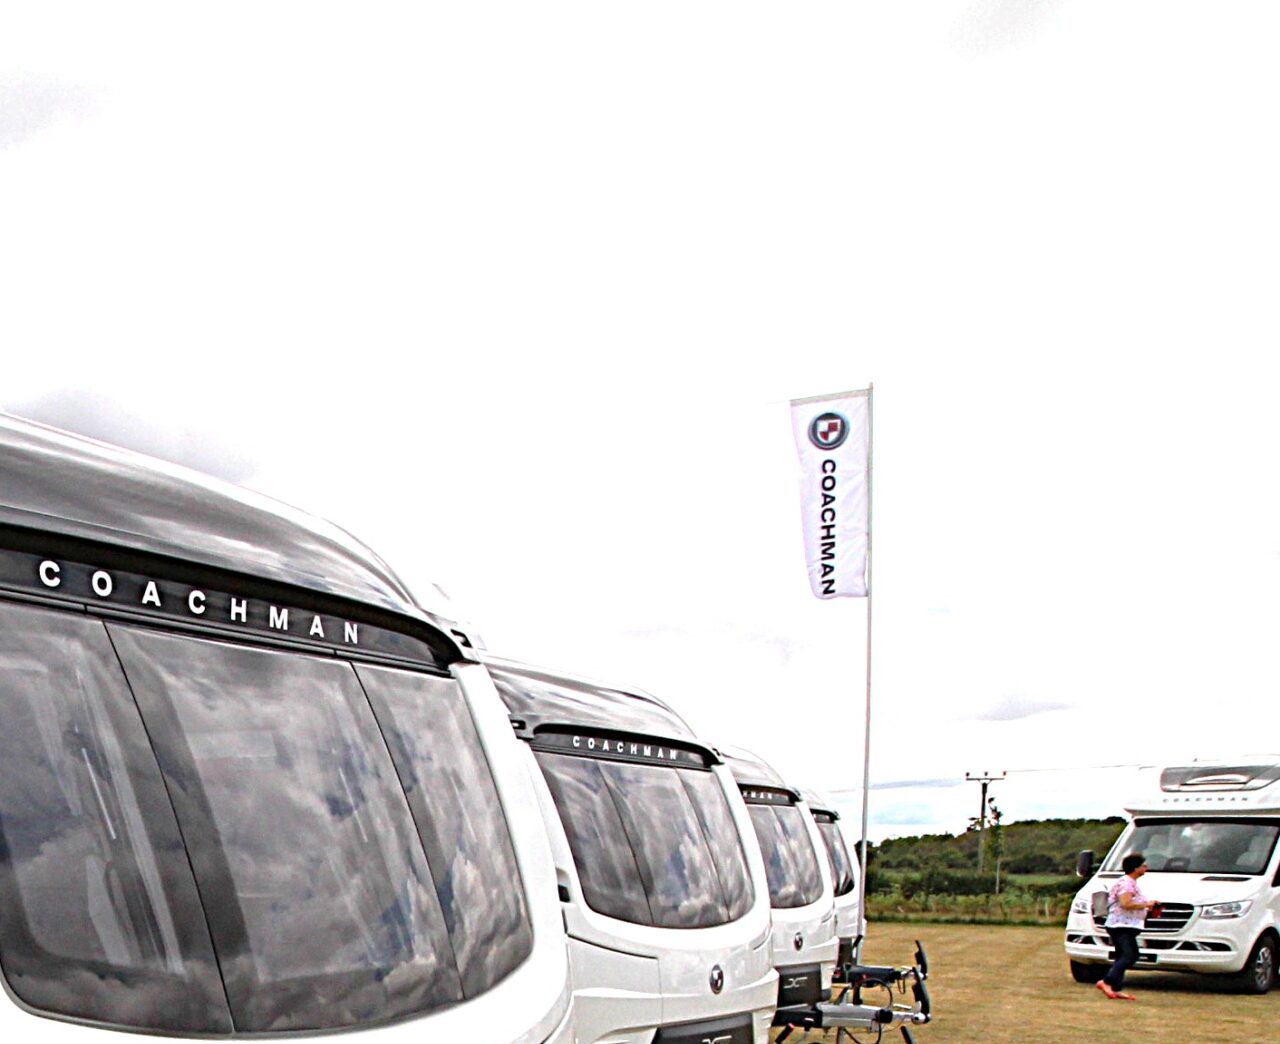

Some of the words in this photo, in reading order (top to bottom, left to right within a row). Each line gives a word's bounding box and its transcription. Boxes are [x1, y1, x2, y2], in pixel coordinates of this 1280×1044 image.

[820, 458, 837, 596] COACHMAN
[38, 559, 359, 644] COACHMAN
[572, 735, 677, 760] COACHMAN
